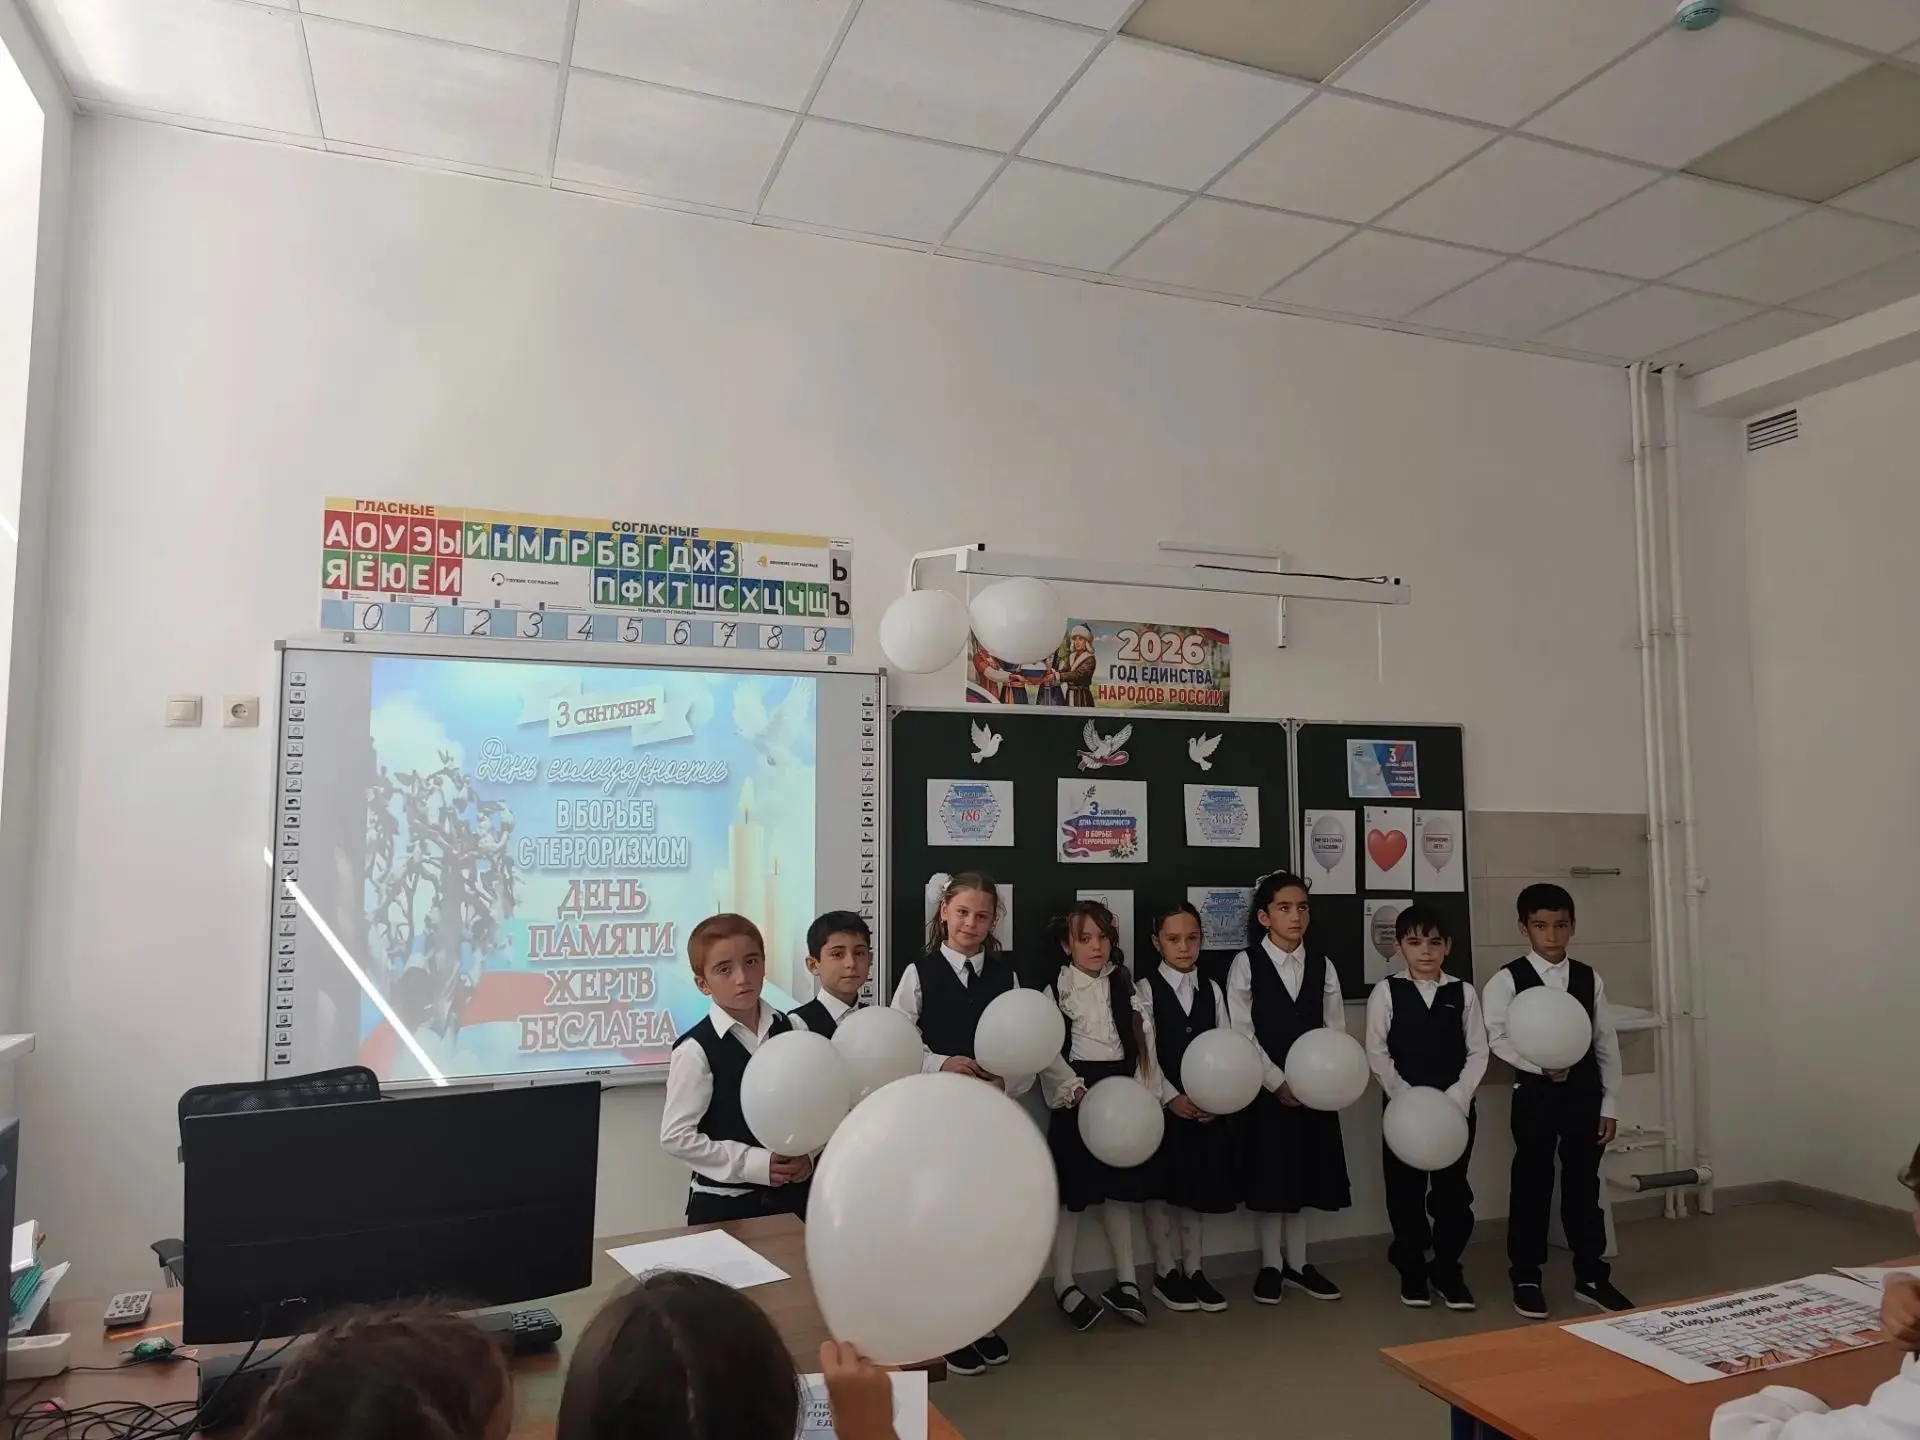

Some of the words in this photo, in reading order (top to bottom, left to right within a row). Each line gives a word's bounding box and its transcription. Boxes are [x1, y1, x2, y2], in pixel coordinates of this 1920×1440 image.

[355, 500, 435, 517] ГЛАСНЫЕ
[612, 520, 699, 538] СОГЛАСНЫЕ
[363, 603, 382, 630] 0
[423, 606, 438, 633] 1
[471, 609, 491, 636] 2
[522, 612, 543, 638] 3
[578, 614, 593, 640] 4
[624, 616, 642, 643] 5
[673, 620, 690, 645] 6
[720, 622, 737, 647] 7
[767, 625, 782, 649] 8
[811, 628, 826, 651] 9
[1117, 628, 1205, 665] 2026
[1110, 664, 1139, 682] ГОД
[1141, 666, 1212, 685] ЕДИНСТВА
[1099, 685, 1165, 704] НАРОДОВ
[1168, 689, 1224, 706] РОССИИ
[556, 701, 571, 728] 3
[574, 698, 656, 726] СЕНТЯБРЯ
[477, 737, 538, 784] День
[547, 752, 728, 797] солидарности
[1389, 747, 1397, 762] 3
[557, 800, 571, 828] В
[574, 800, 653, 829] БОРЬБЕ
[961, 810, 980, 822] 186
[1089, 801, 1099, 816] 3
[517, 837, 534, 866] С
[536, 836, 688, 866] ТЕРРОРИЗМОМ
[558, 878, 647, 919] ДЕНЬ
[528, 922, 675, 959] ПАМЯТИ
[545, 967, 655, 1005] ЖЕРТВ
[518, 1010, 676, 1051] БЕСЛАНА
[814, 1402, 830, 1410] ПО
[816, 1419, 833, 1427] ЕД
